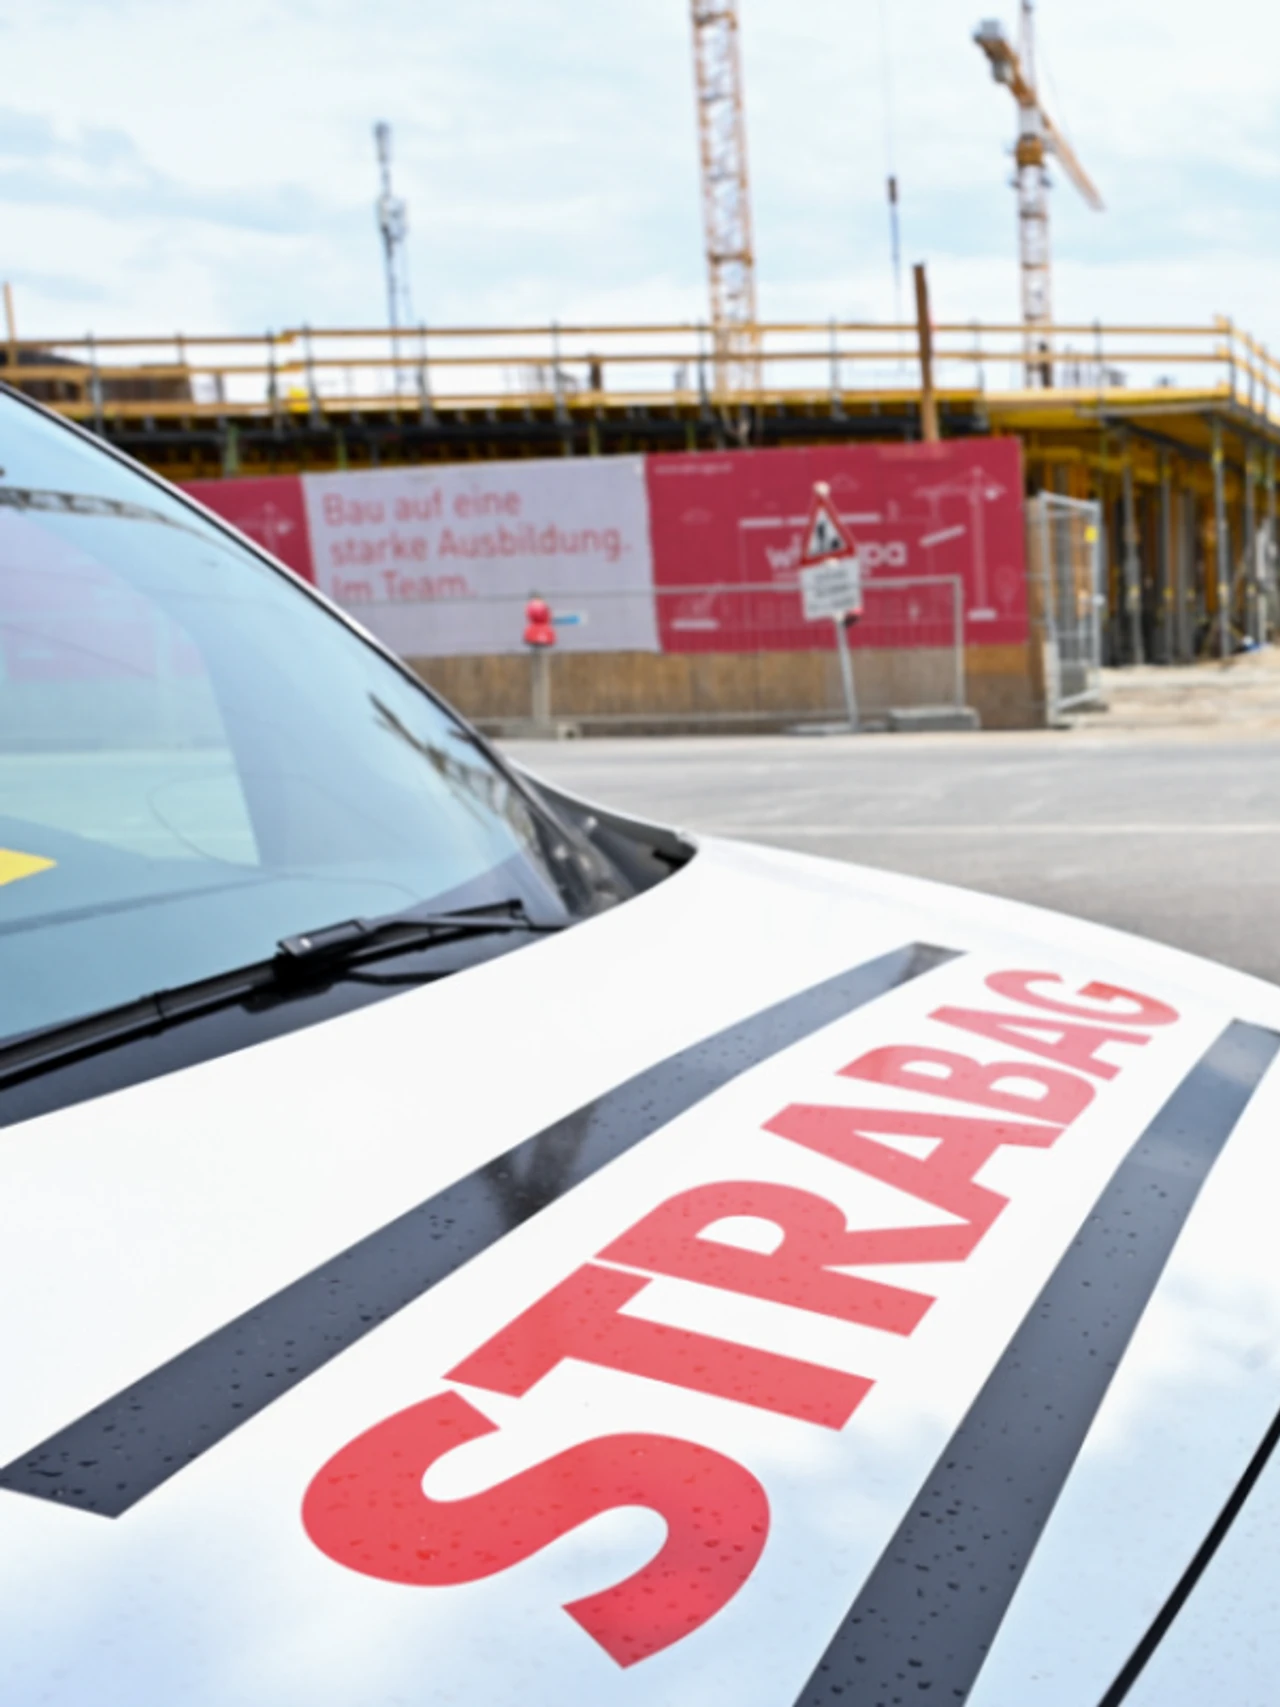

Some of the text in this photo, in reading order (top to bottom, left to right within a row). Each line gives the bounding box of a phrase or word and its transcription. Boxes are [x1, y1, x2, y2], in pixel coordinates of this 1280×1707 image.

[323, 484, 521, 526] Bau auf eine
[330, 524, 631, 566] starke Ausbildung.
[381, 570, 477, 599] Team.
[301, 968, 1180, 1669] STRABAG
